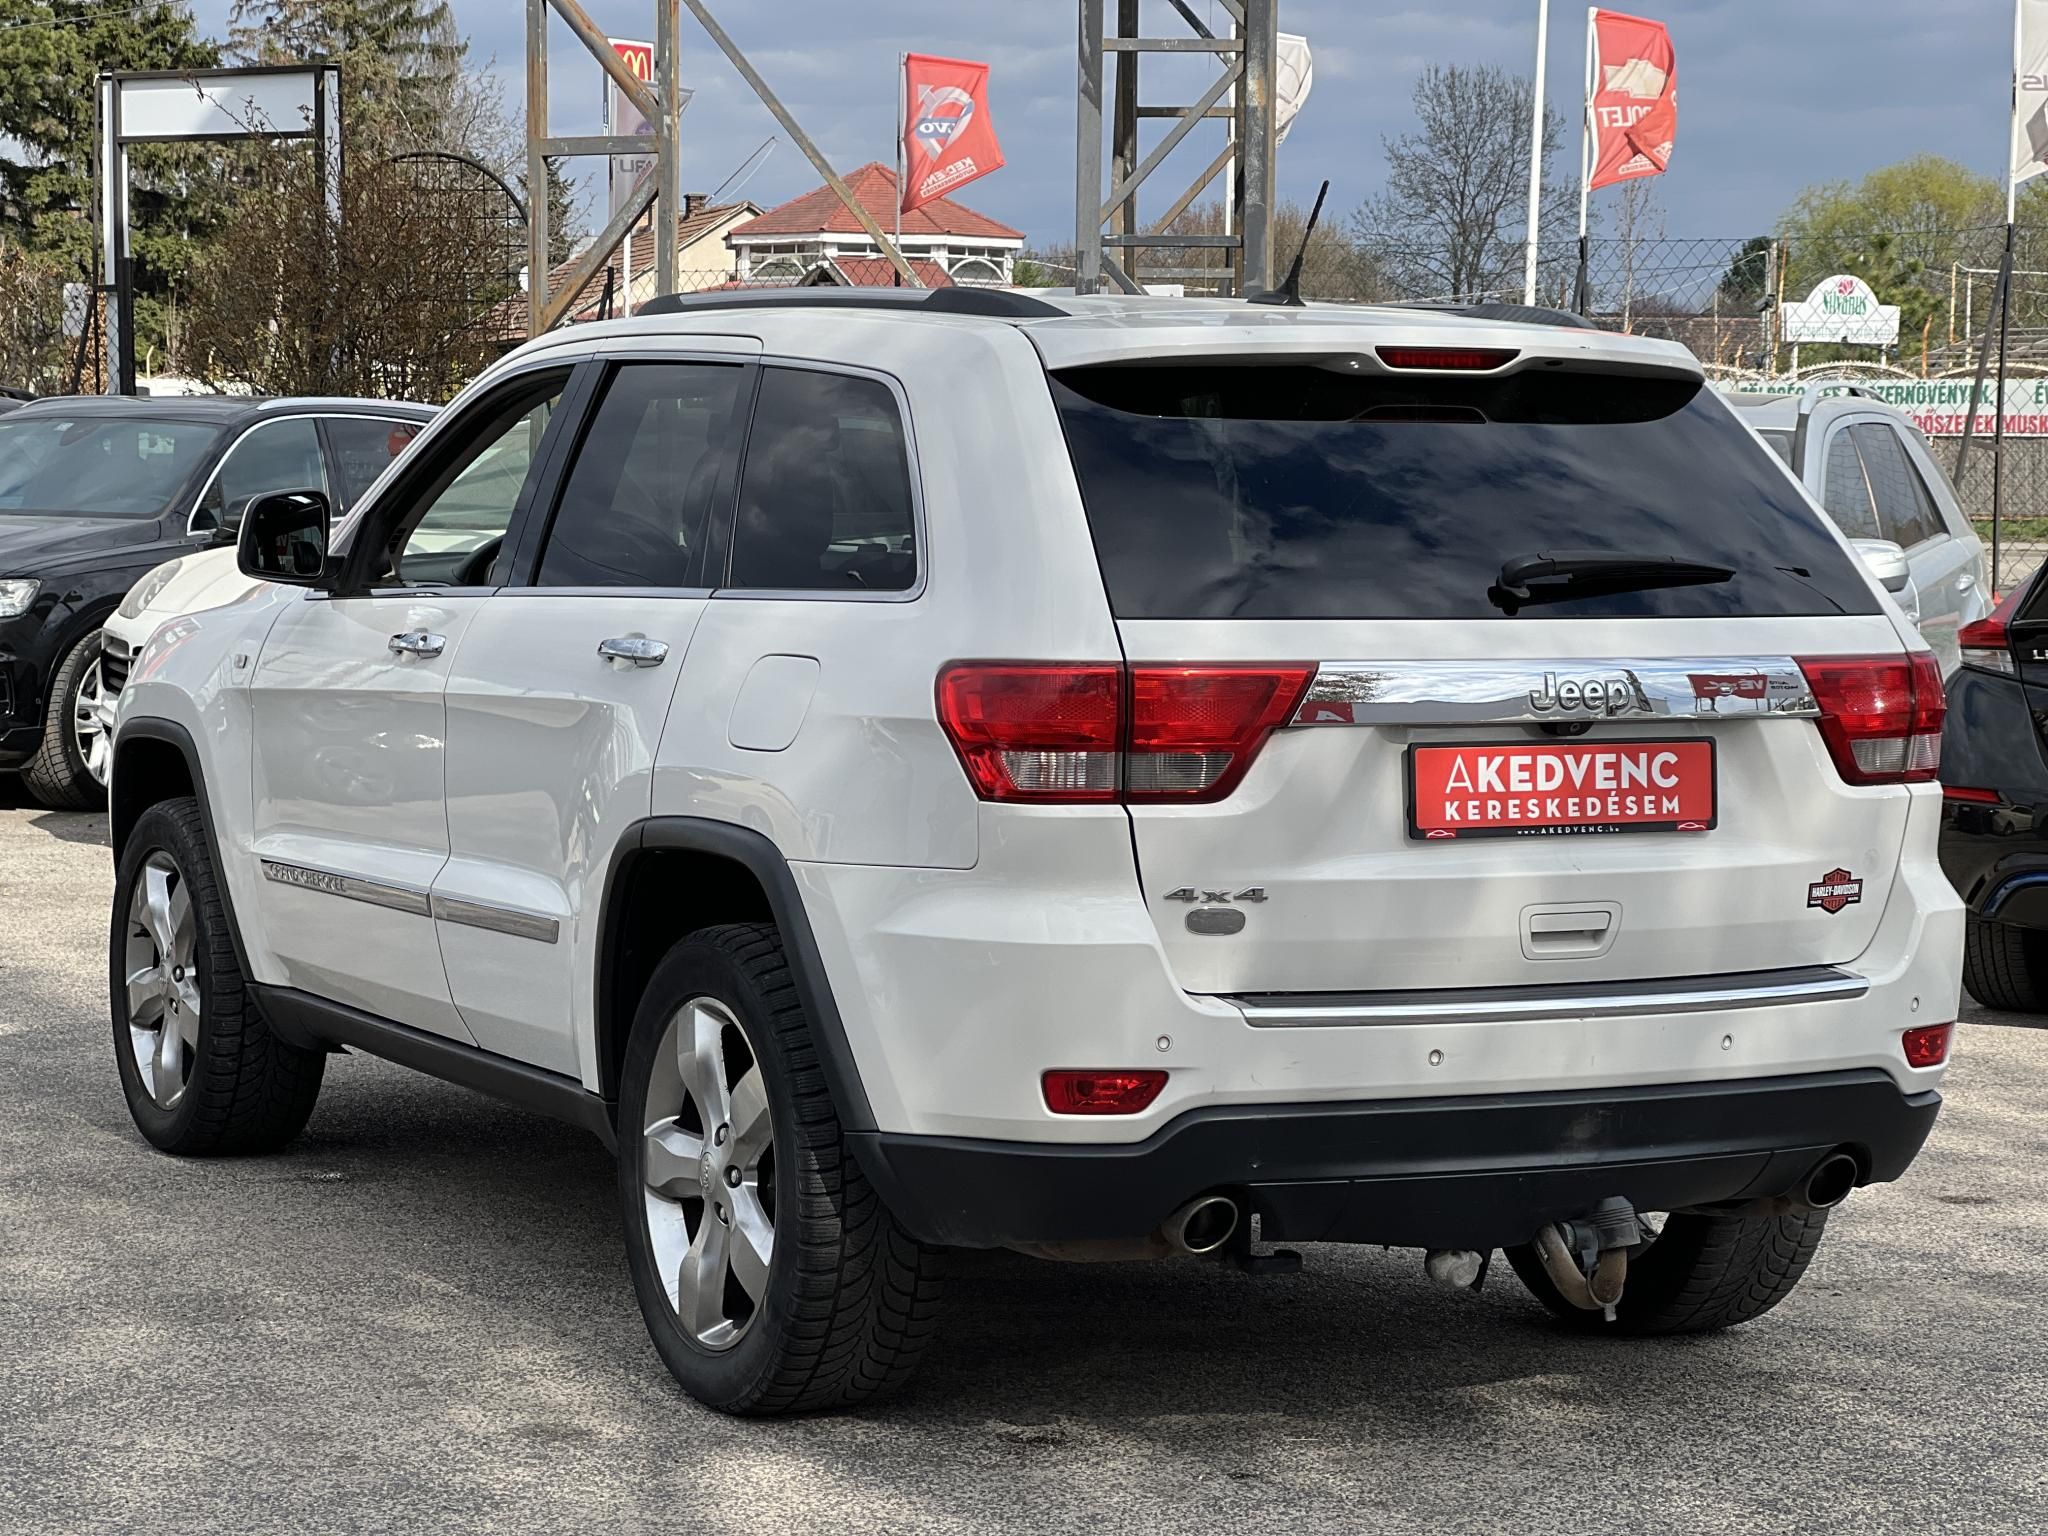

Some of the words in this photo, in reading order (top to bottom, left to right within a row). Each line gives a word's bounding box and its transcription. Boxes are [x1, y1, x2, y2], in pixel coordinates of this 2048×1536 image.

[1529, 671, 1630, 716] Jeep
[1445, 791, 1680, 821] KERESKEDÉSEM
[270, 863, 299, 881] GRAND
[301, 869, 346, 892] CHEROKEE
[1811, 883, 1860, 898] HARLEY-DAVIDSON
